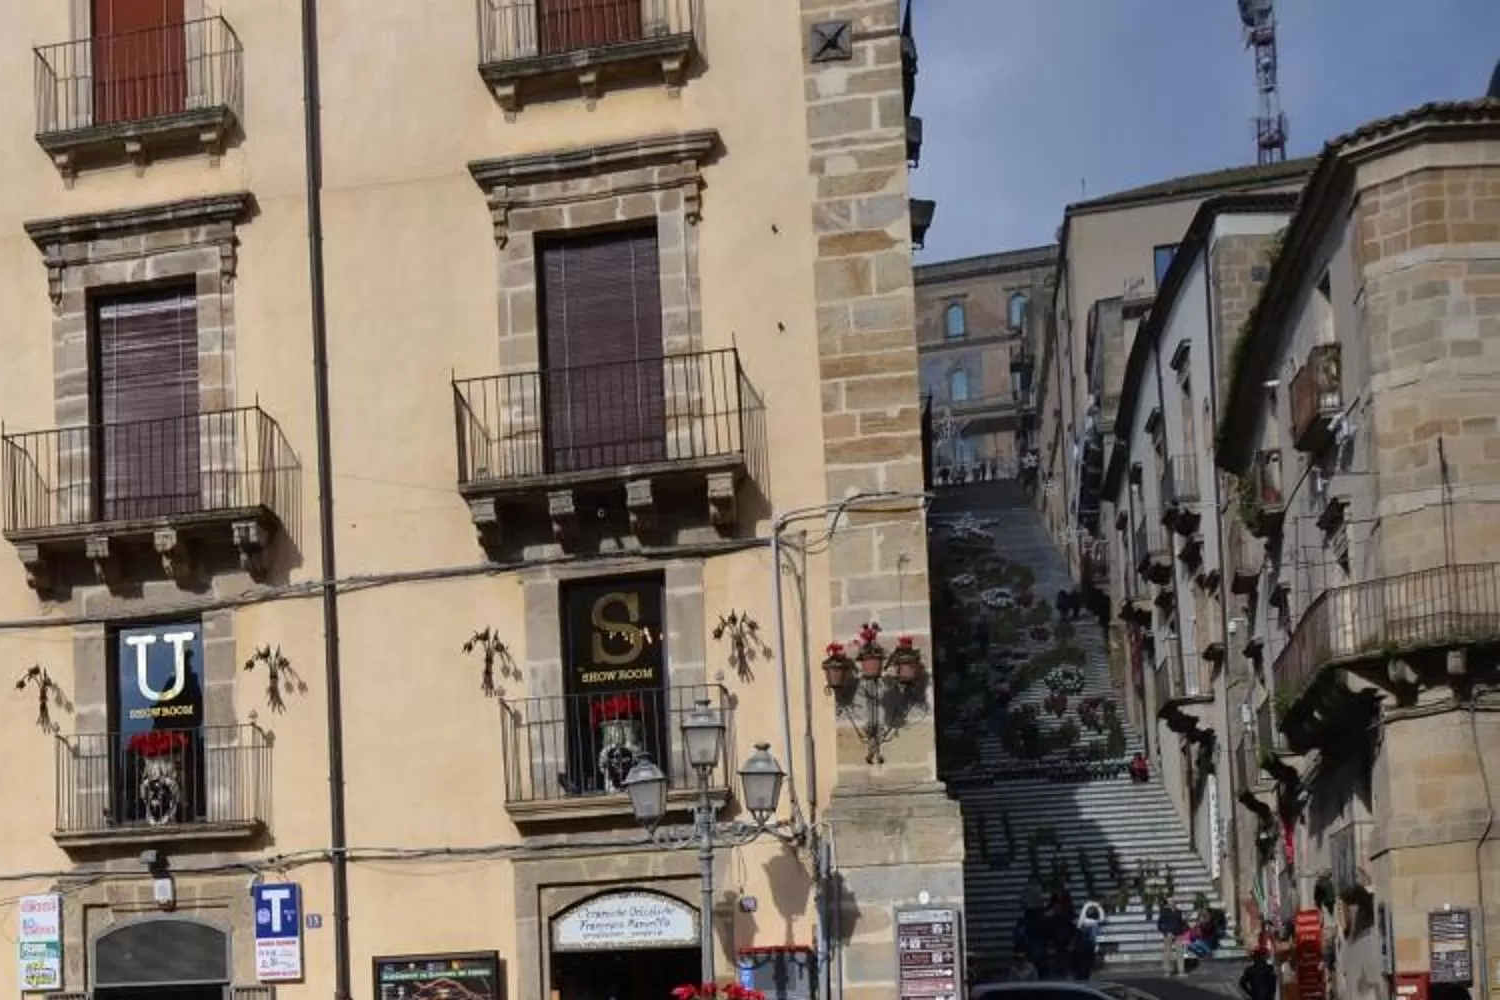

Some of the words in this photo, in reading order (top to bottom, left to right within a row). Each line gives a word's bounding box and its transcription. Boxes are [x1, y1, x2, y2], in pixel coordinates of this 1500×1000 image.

[591, 591, 644, 666] S
[126, 631, 195, 701] U
[581, 670, 617, 683] SHOW
[617, 667, 653, 680] ROOM
[261, 889, 291, 933] T
